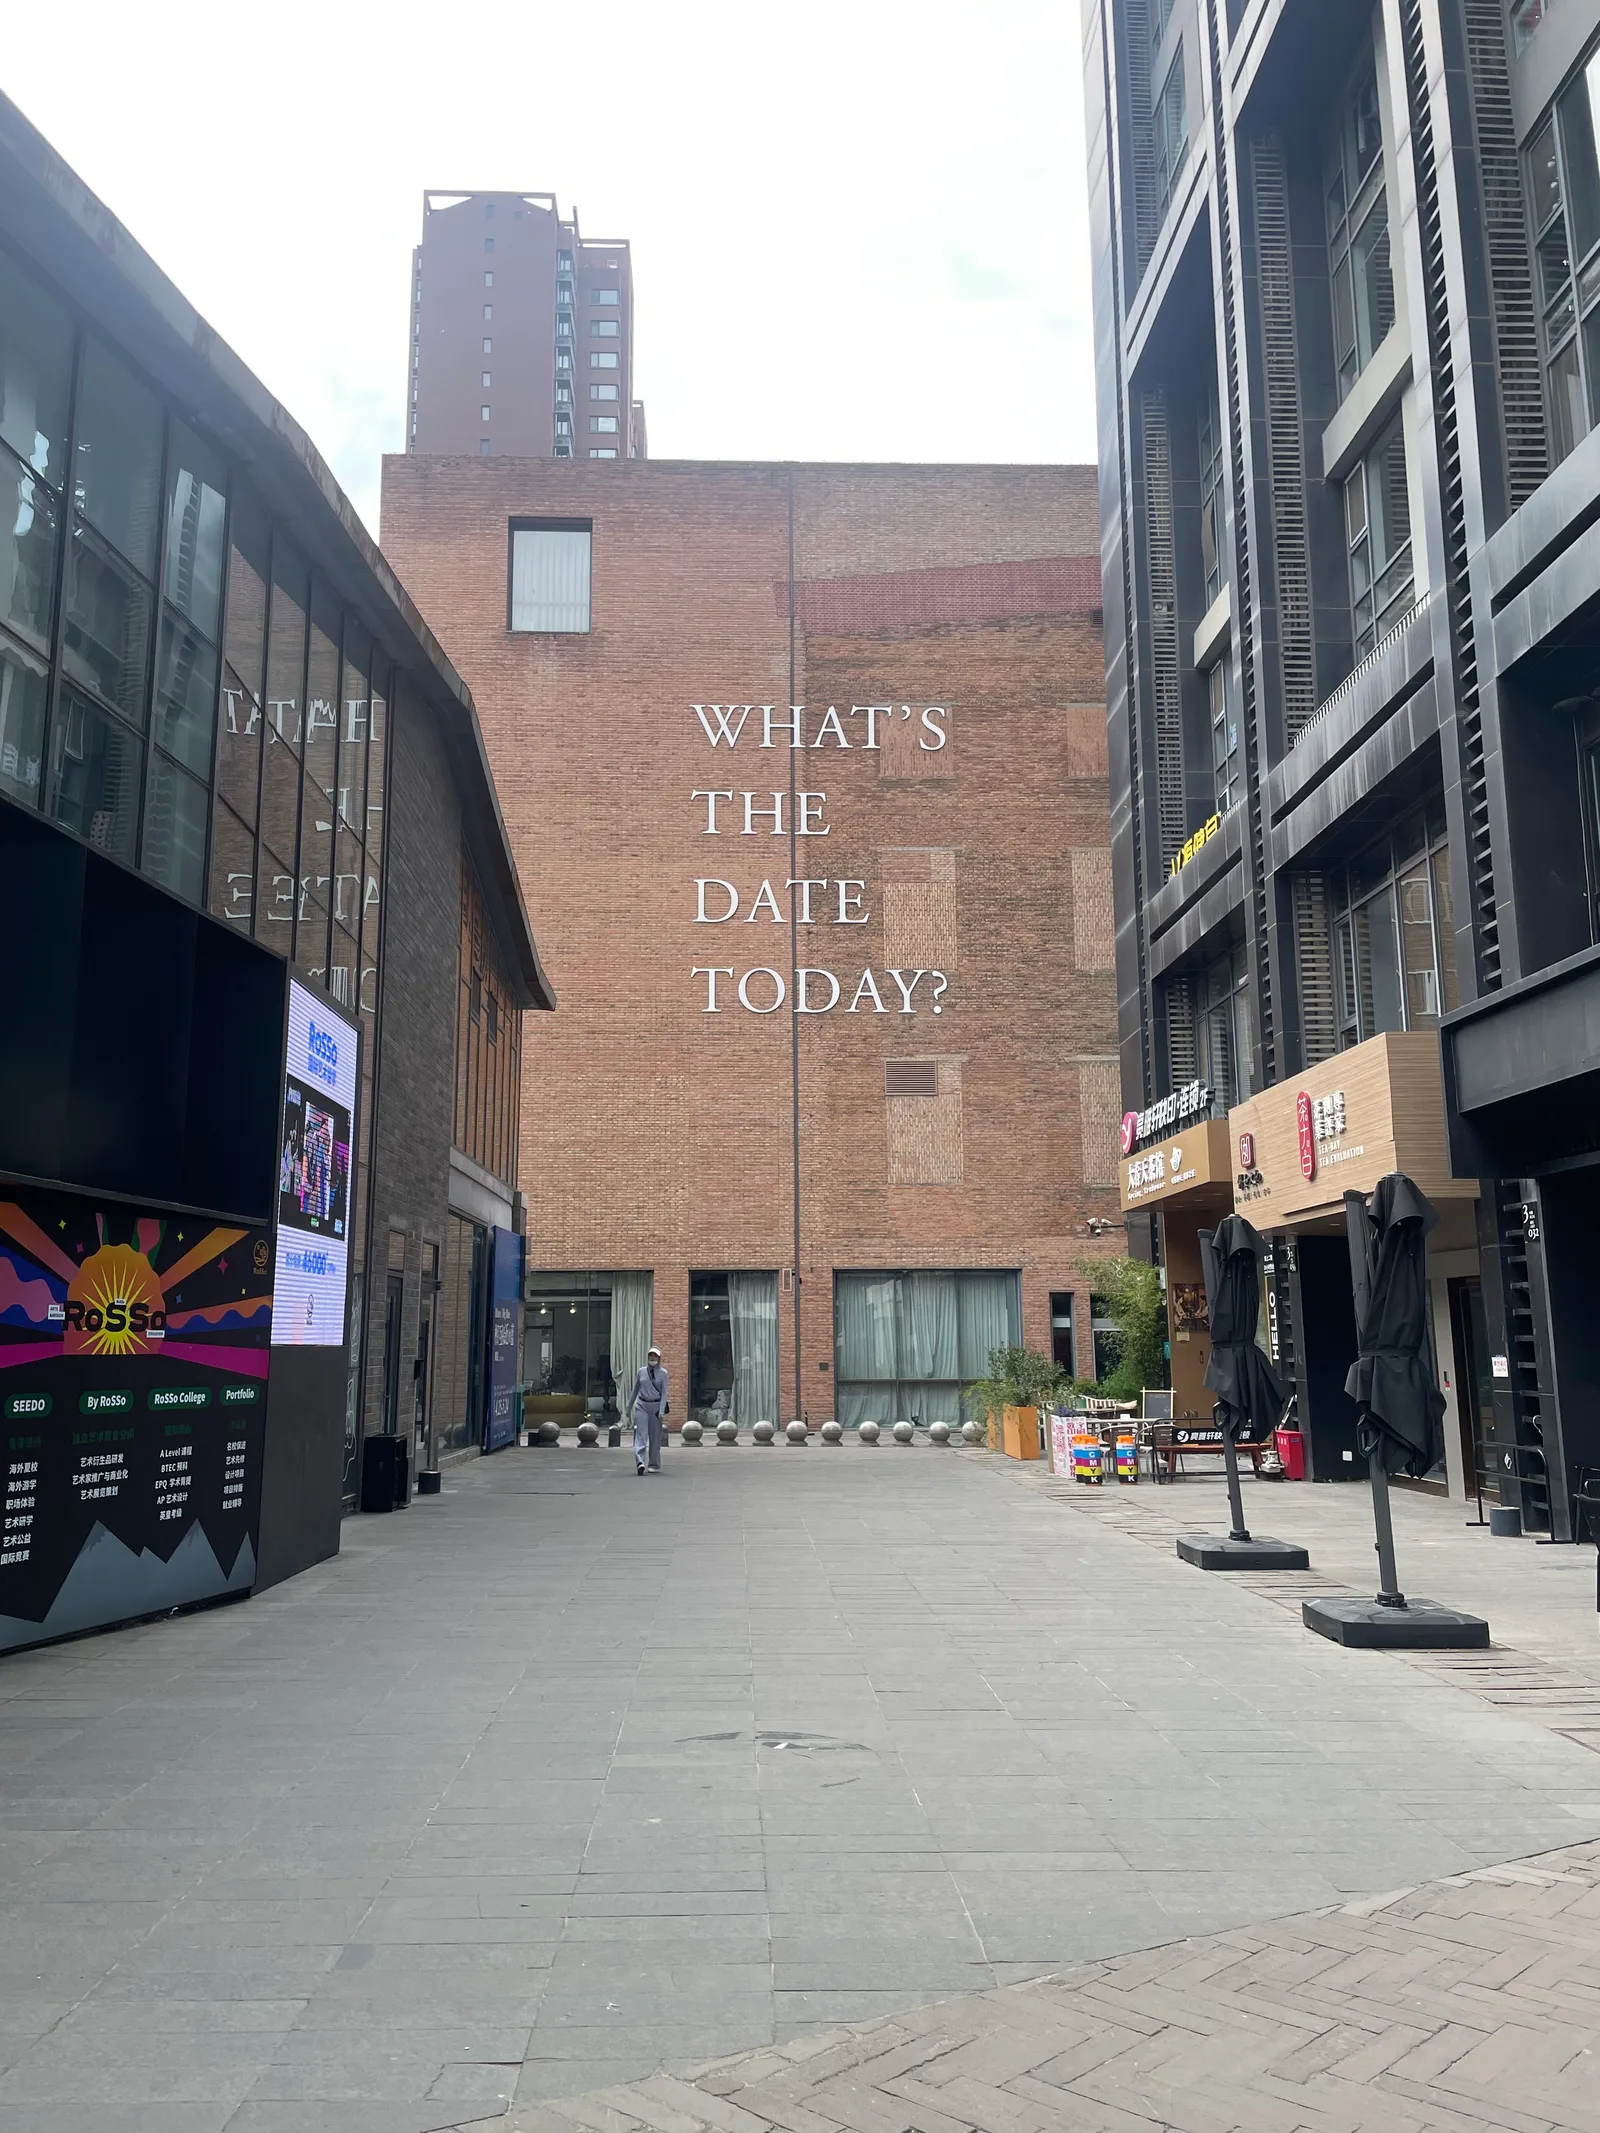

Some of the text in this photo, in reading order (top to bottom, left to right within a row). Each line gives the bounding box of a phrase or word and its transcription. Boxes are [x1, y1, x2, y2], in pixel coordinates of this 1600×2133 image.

[689, 704, 947, 751] WHAT'S
[690, 789, 831, 836] THE
[692, 878, 870, 924] DATE
[690, 966, 948, 1015] TODAY?
[1319, 1145, 1364, 1168] TEA EVALUATION
[1522, 1204, 1529, 1224] 3
[1528, 1228, 1539, 1240] 032
[62, 1301, 166, 1332] RoSSo
[1268, 1291, 1280, 1360] HELLO
[154, 1392, 206, 1404] RoSSo College
[226, 1388, 254, 1400] Portfolio
[13, 1399, 46, 1412] SEEDO
[87, 1395, 126, 1410] By RoSSo
[165, 1448, 180, 1458] Level
[80, 1453, 124, 1468] 艺术衍生品研发
[9, 1462, 38, 1474] 海外夏校
[161, 1463, 176, 1473] BTEC
[72, 1469, 128, 1485] 艺术家推广与商业化
[8, 1479, 36, 1492] 海外游学
[155, 1480, 167, 1490] EPQ
[157, 1492, 188, 1505] AP 艺术设计
[4, 1515, 34, 1528] 艺术研学
[3, 1533, 32, 1547] 艺术公益
[0, 1550, 30, 1565] 国际竞赛
